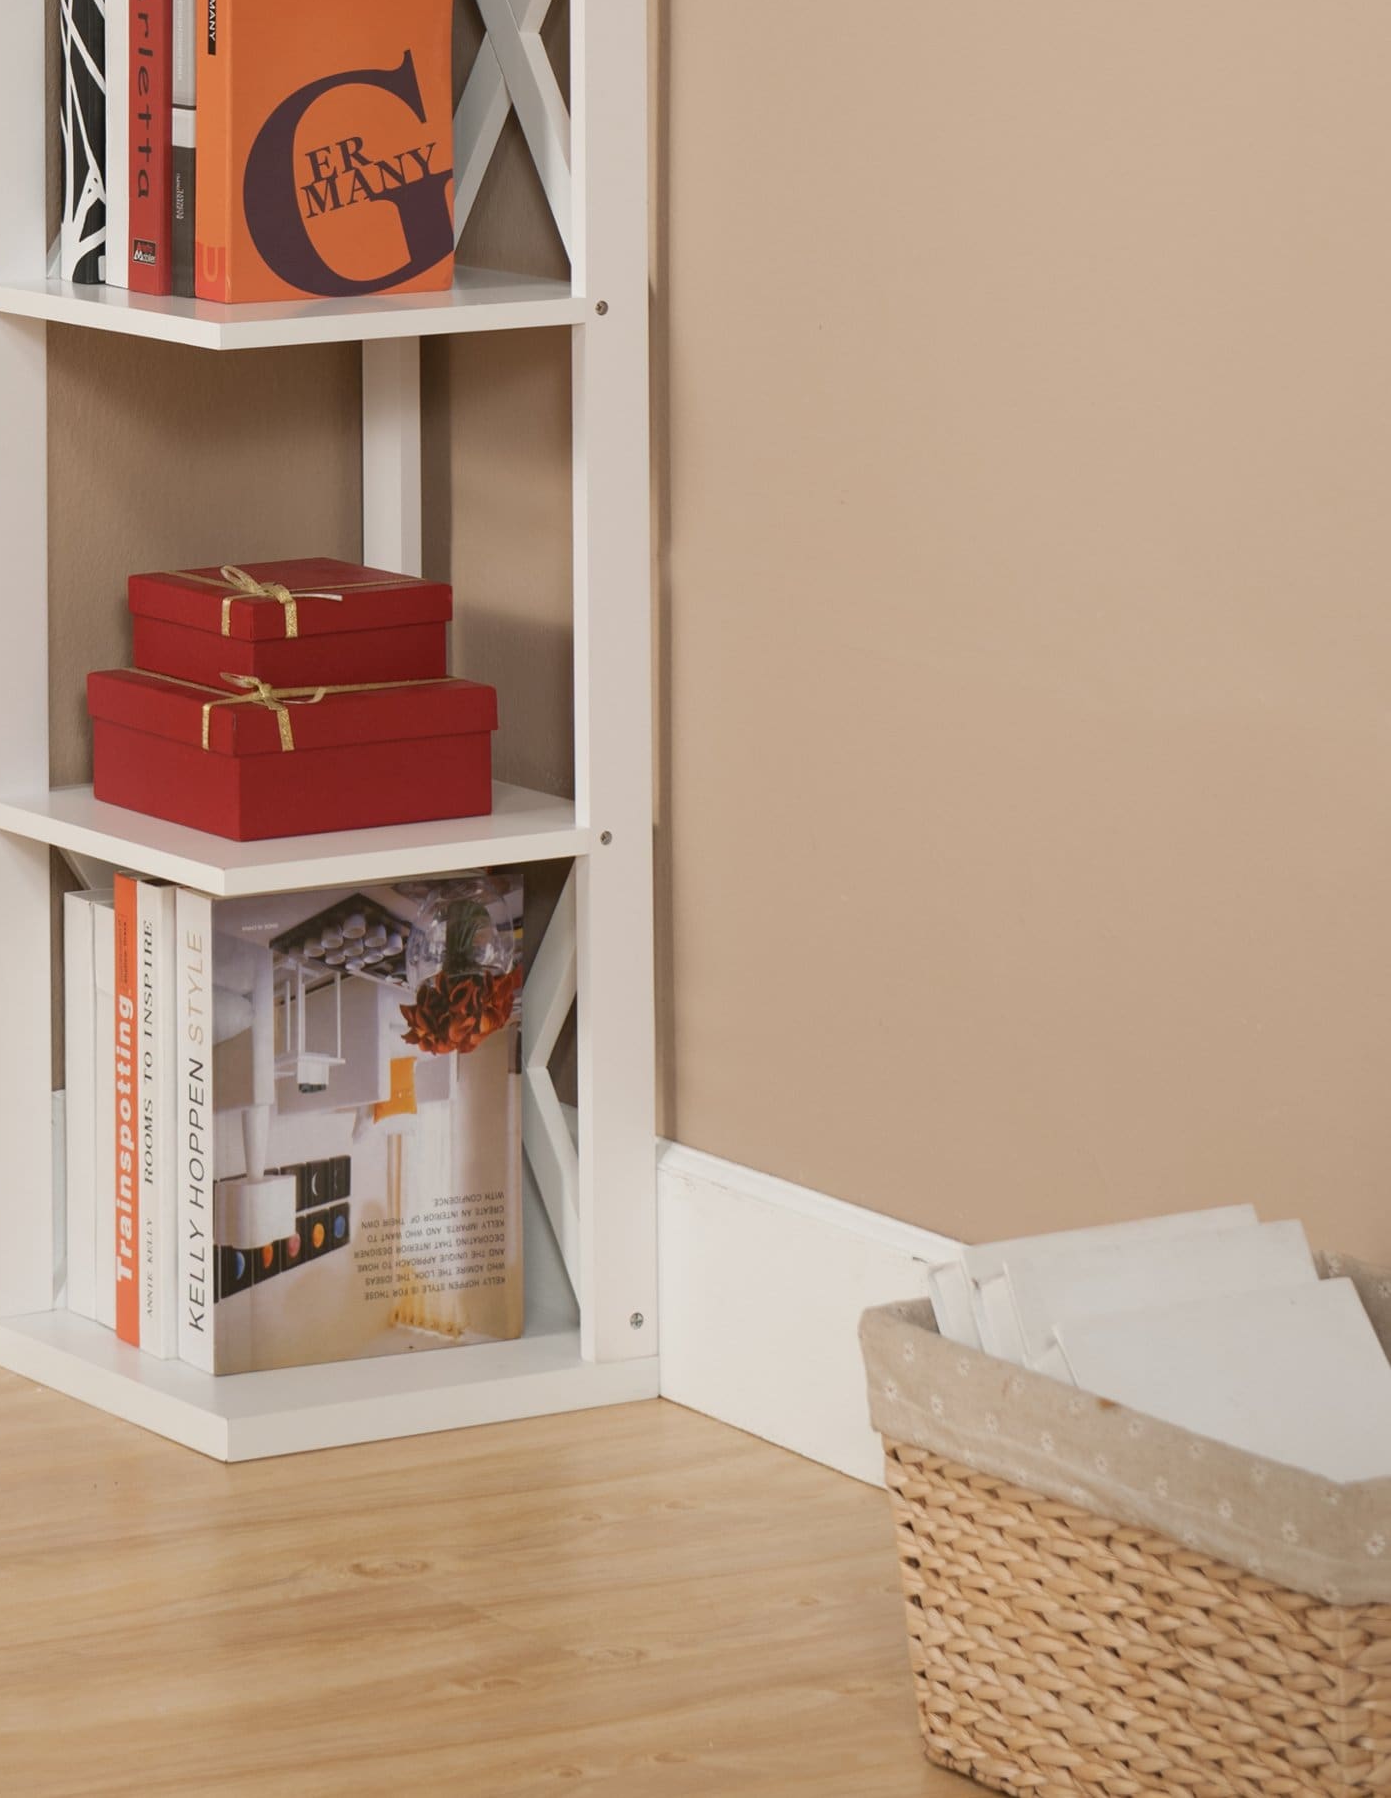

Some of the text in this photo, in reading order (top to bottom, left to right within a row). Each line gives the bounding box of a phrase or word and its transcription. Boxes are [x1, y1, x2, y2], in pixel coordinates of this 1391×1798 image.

[305, 136, 374, 183] ER
[243, 49, 454, 298] G
[300, 142, 437, 219] MANY
[143, 919, 154, 1319] ANNIE KELLY ROOMS TO INSPIRE
[186, 929, 206, 1332] KELLY HOPPEN STYLE
[116, 993, 135, 1282] Trainspotting
[434, 1192, 504, 1206] WITH CONFIDENCE
[462, 1209, 471, 1217] AN
[475, 1205, 504, 1215] CREATE
[424, 1211, 458, 1222] INTERIOR
[361, 1220, 379, 1228] OWN
[482, 1219, 504, 1230] KELLY
[405, 1230, 422, 1238] WHO
[426, 1227, 441, 1235] AND
[354, 1234, 504, 1258] DECORATING THAT INTERIOR DESIGNER
[471, 1251, 485, 1259] THE
[489, 1249, 504, 1257] AND
[382, 1260, 392, 1268] TO
[396, 1257, 436, 1267] APPROACH
[437, 1268, 452, 1276] THE
[487, 1263, 505, 1272] WHO
[397, 1274, 409, 1282] THE
[422, 1283, 444, 1293] STYLE
